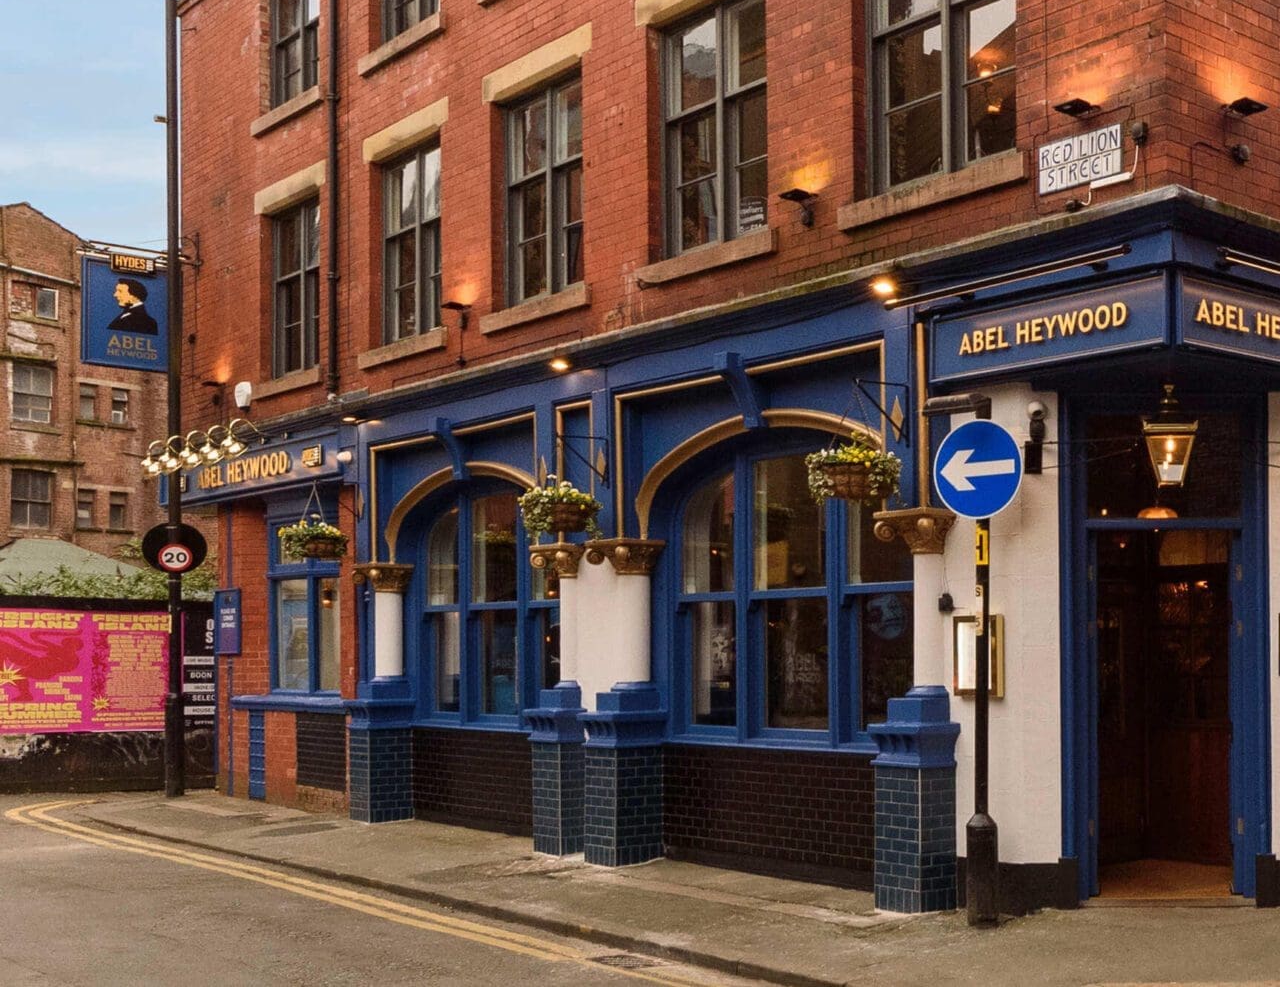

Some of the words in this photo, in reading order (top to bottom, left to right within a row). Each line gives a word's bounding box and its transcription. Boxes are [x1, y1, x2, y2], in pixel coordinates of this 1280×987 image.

[1041, 142, 1073, 168] RED
[1079, 128, 1119, 158] LION
[1047, 152, 1112, 187] STREET
[115, 255, 146, 270] HYDES
[1196, 298, 1250, 334] ABEL
[958, 326, 1009, 357] ABEL
[1016, 301, 1128, 347] HEYWOOD
[108, 334, 157, 352] ABEL
[106, 348, 158, 361] HEYWOOD
[197, 465, 224, 489] ABEL
[227, 451, 288, 484] HEYWOOD
[164, 552, 187, 563] 20
[0, 612, 84, 622] REIGHT
[92, 614, 169, 623] FREIGH
[0, 711, 82, 719] UMMER
